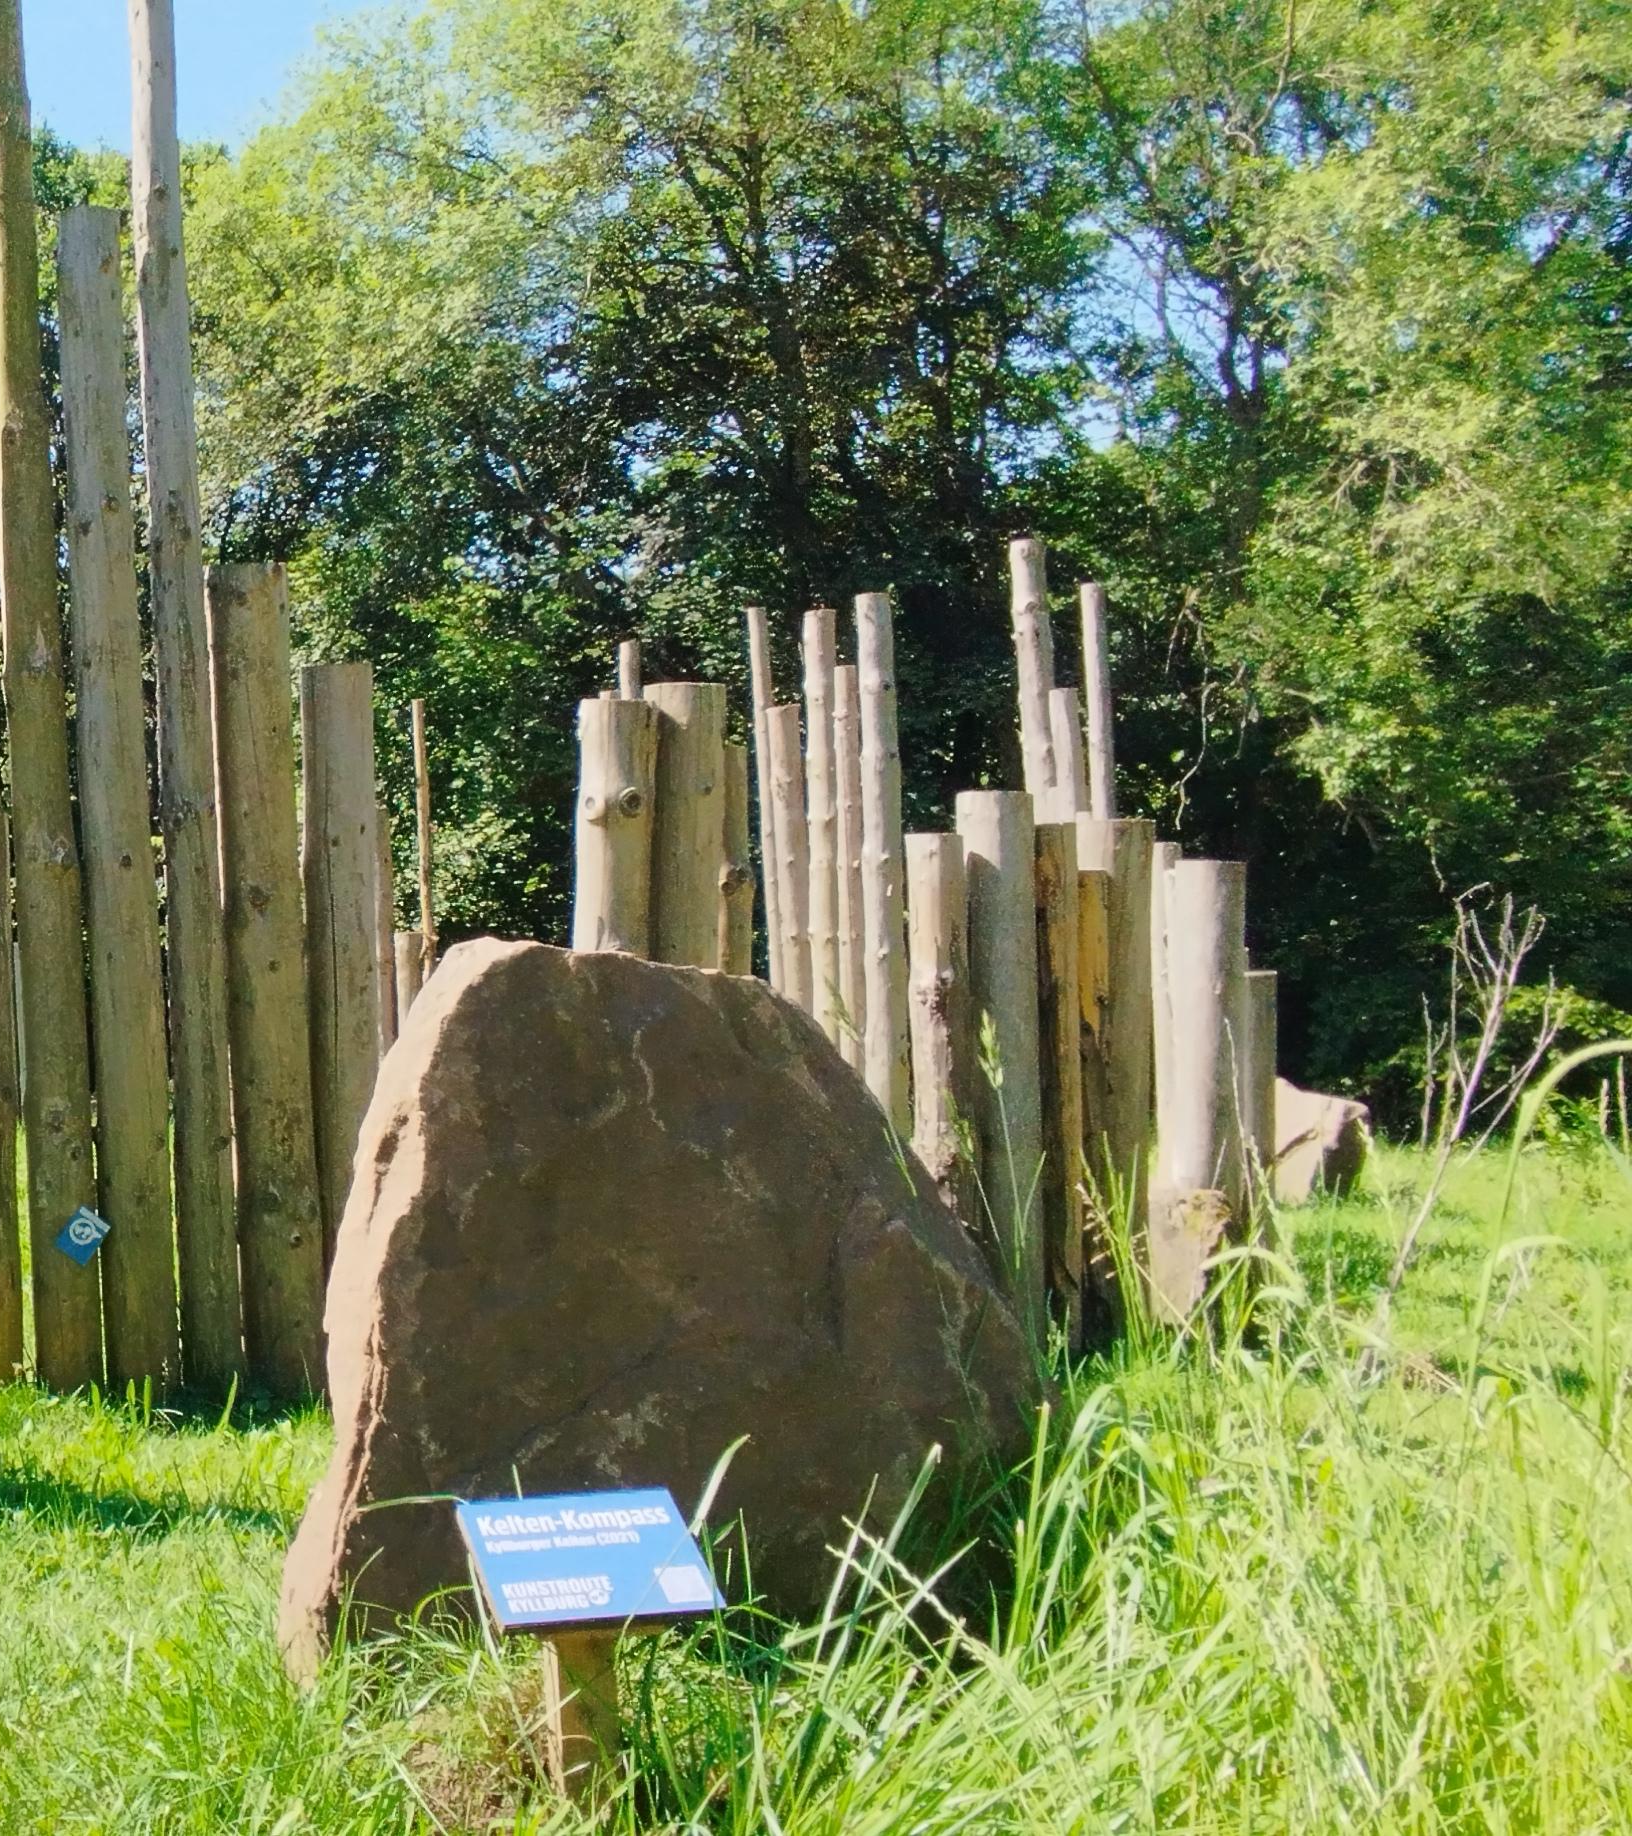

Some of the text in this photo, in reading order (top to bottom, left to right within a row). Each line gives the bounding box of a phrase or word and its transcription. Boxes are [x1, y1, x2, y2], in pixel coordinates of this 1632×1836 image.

[476, 1506, 671, 1537] Kelten-Kompass
[501, 1576, 614, 1598] KUNSTROUTE
[508, 1592, 590, 1614] KYLLBURG
